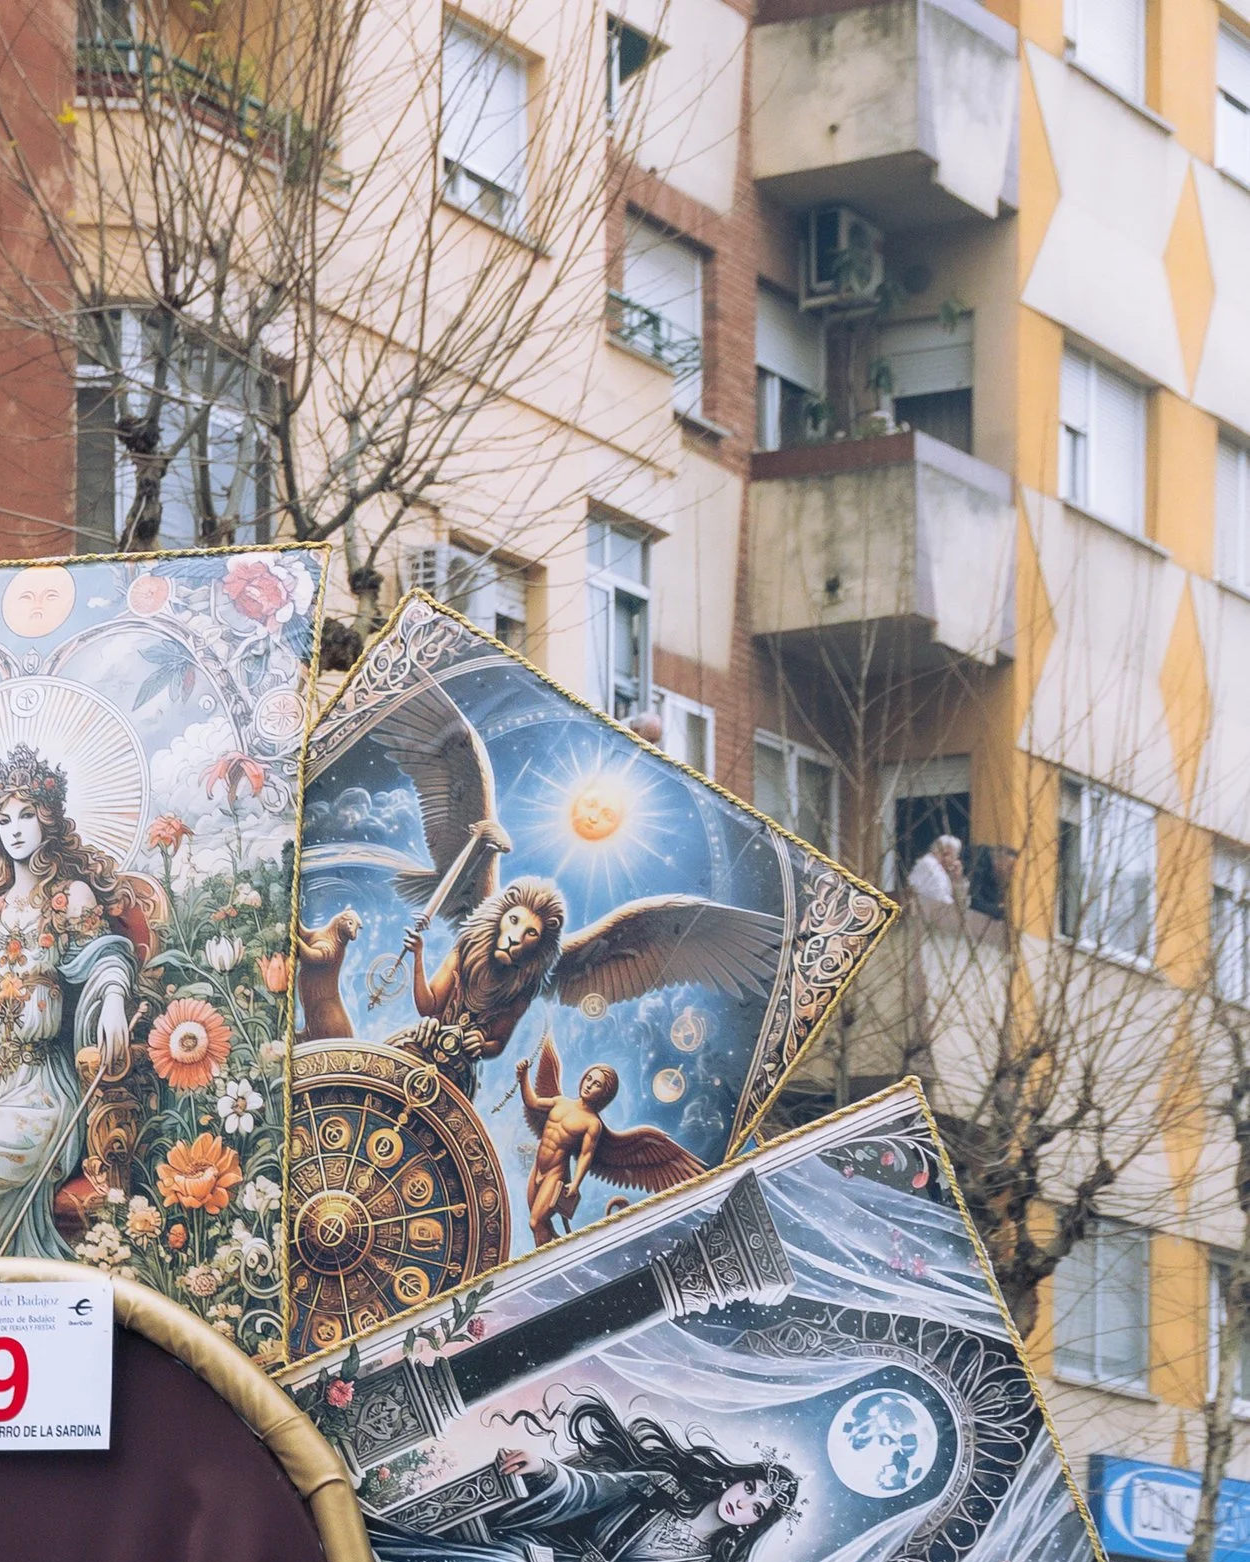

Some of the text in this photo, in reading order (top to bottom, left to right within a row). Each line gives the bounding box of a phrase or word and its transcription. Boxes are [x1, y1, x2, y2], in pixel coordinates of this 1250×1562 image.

[0, 1295, 14, 1307] de
[17, 1294, 60, 1308] Badajoz
[16, 1315, 27, 1324] de
[28, 1314, 56, 1324] Badajoz
[23, 1425, 38, 1438] DE
[39, 1424, 54, 1438] LA
[55, 1424, 102, 1438] SARDINA
